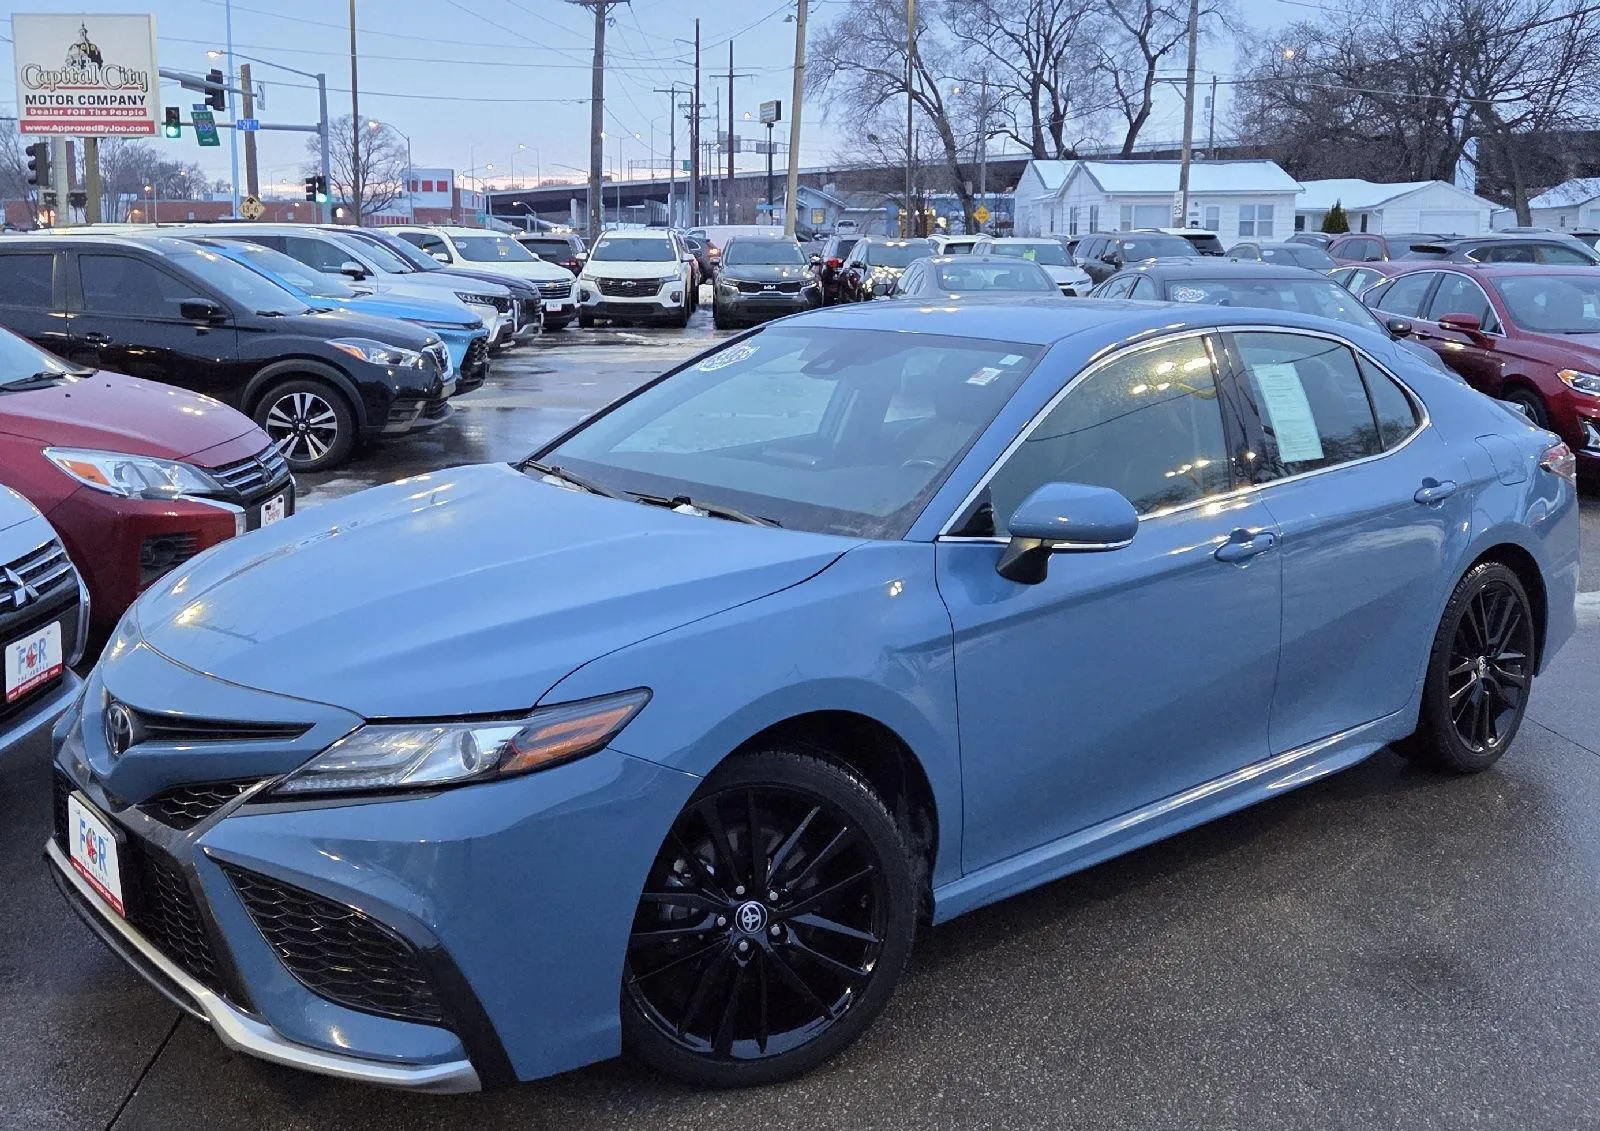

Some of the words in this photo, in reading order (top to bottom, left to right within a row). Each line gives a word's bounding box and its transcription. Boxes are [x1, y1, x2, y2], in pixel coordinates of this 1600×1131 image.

[21, 62, 101, 92] Capital
[101, 63, 149, 93] City
[25, 94, 75, 106] MOTOR
[78, 94, 146, 106] COMPANY
[89, 108, 107, 116] The
